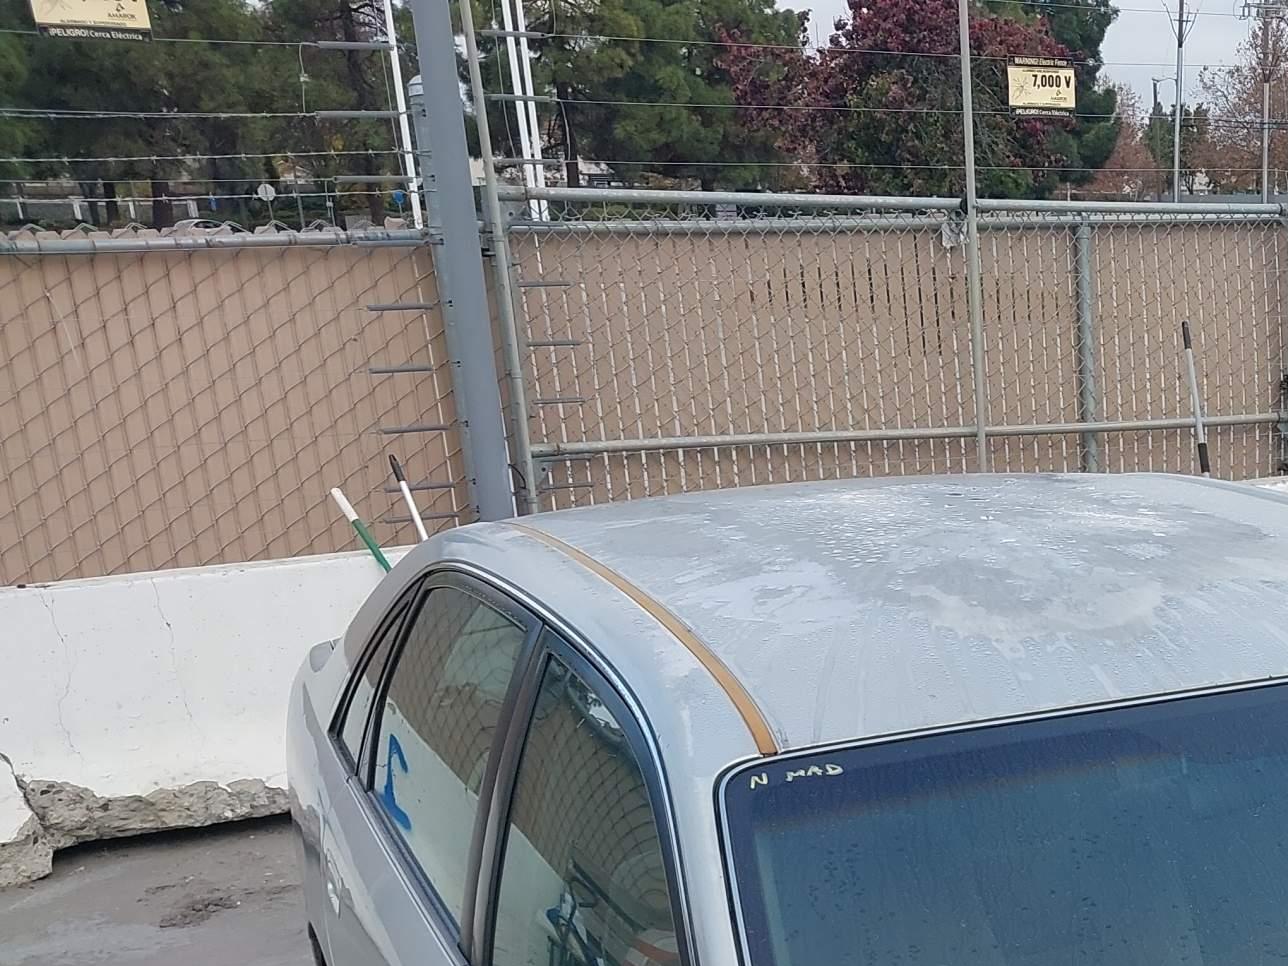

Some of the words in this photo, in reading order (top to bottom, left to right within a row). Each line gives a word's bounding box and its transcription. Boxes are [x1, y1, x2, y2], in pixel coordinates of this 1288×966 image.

[89, 30, 111, 39] Cerca
[1032, 74, 1062, 89] 7,000
[1064, 75, 1071, 88] V
[750, 772, 769, 789] N
